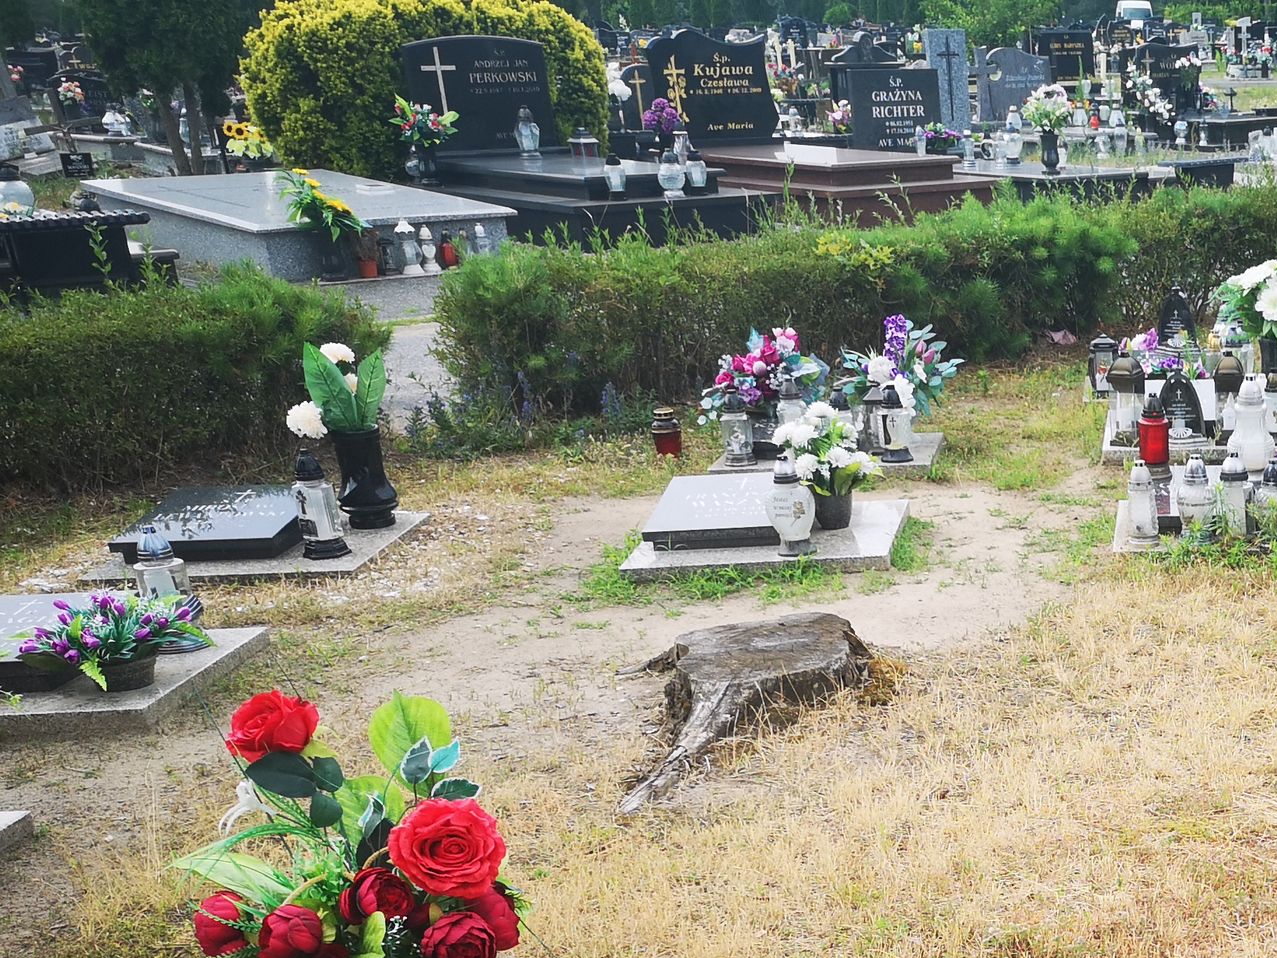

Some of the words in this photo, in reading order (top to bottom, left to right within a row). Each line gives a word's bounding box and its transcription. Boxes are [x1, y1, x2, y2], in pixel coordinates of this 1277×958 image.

[514, 59, 529, 68] JAN
[693, 63, 753, 78] Kujawa
[469, 71, 537, 83] PERKOWSKI
[700, 77, 749, 88] Czesława
[889, 76, 903, 87] Ś.P.
[871, 88, 922, 102] GRAŻYNA
[872, 105, 925, 118] RICHTER
[708, 123, 724, 131] Ave
[727, 122, 754, 130] Maria
[879, 139, 894, 147] AVE
